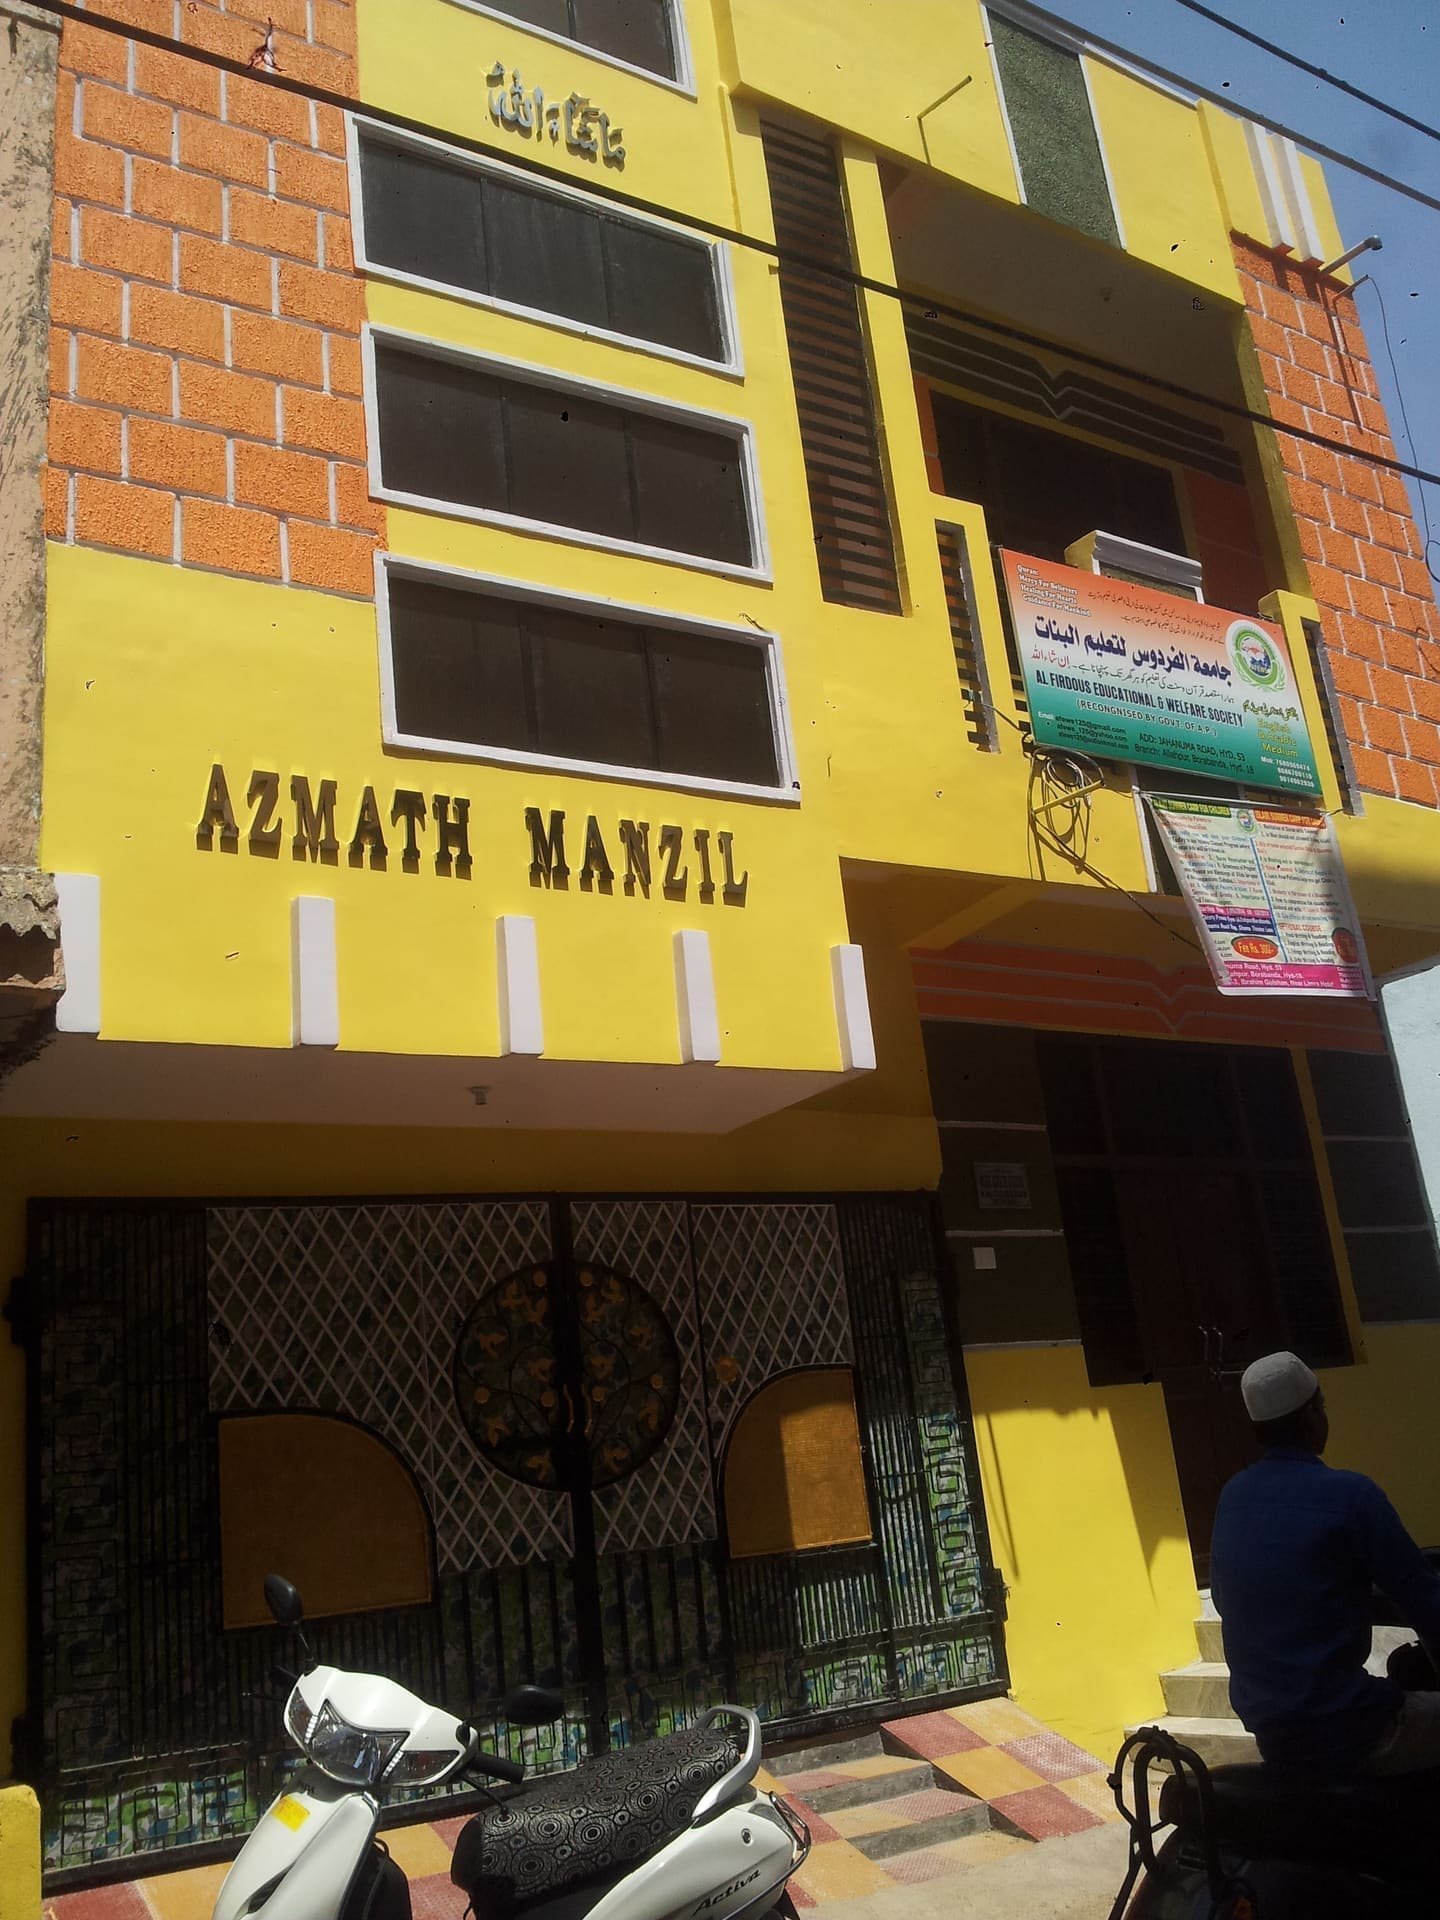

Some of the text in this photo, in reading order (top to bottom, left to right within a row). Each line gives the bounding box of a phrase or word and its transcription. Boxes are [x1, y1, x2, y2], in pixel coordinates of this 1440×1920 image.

[1019, 574, 1078, 595] Mercy For Believers
[1021, 583, 1078, 604] Healing For Hearts
[1022, 594, 1091, 617] Guidance For Mankind
[1035, 616, 1232, 687] جامعة الفردوس لتعليم البنات
[1036, 670, 1049, 686] AL
[1050, 673, 1093, 695] FIRDOUS
[1093, 682, 1157, 708] EDUCATIONAL
[1165, 697, 1208, 719] WELFARE
[1207, 707, 1243, 727] SOCIETY
[1076, 699, 1143, 720] (RECONGNISED
[1144, 712, 1157, 724] BY
[1184, 721, 1196, 732] OF
[1158, 737, 1195, 751] JAHANUMA
[1262, 742, 1298, 758] Medium
[196, 763, 749, 909] AZMATH MANZIL
[692, 1868, 761, 1917] Activa
